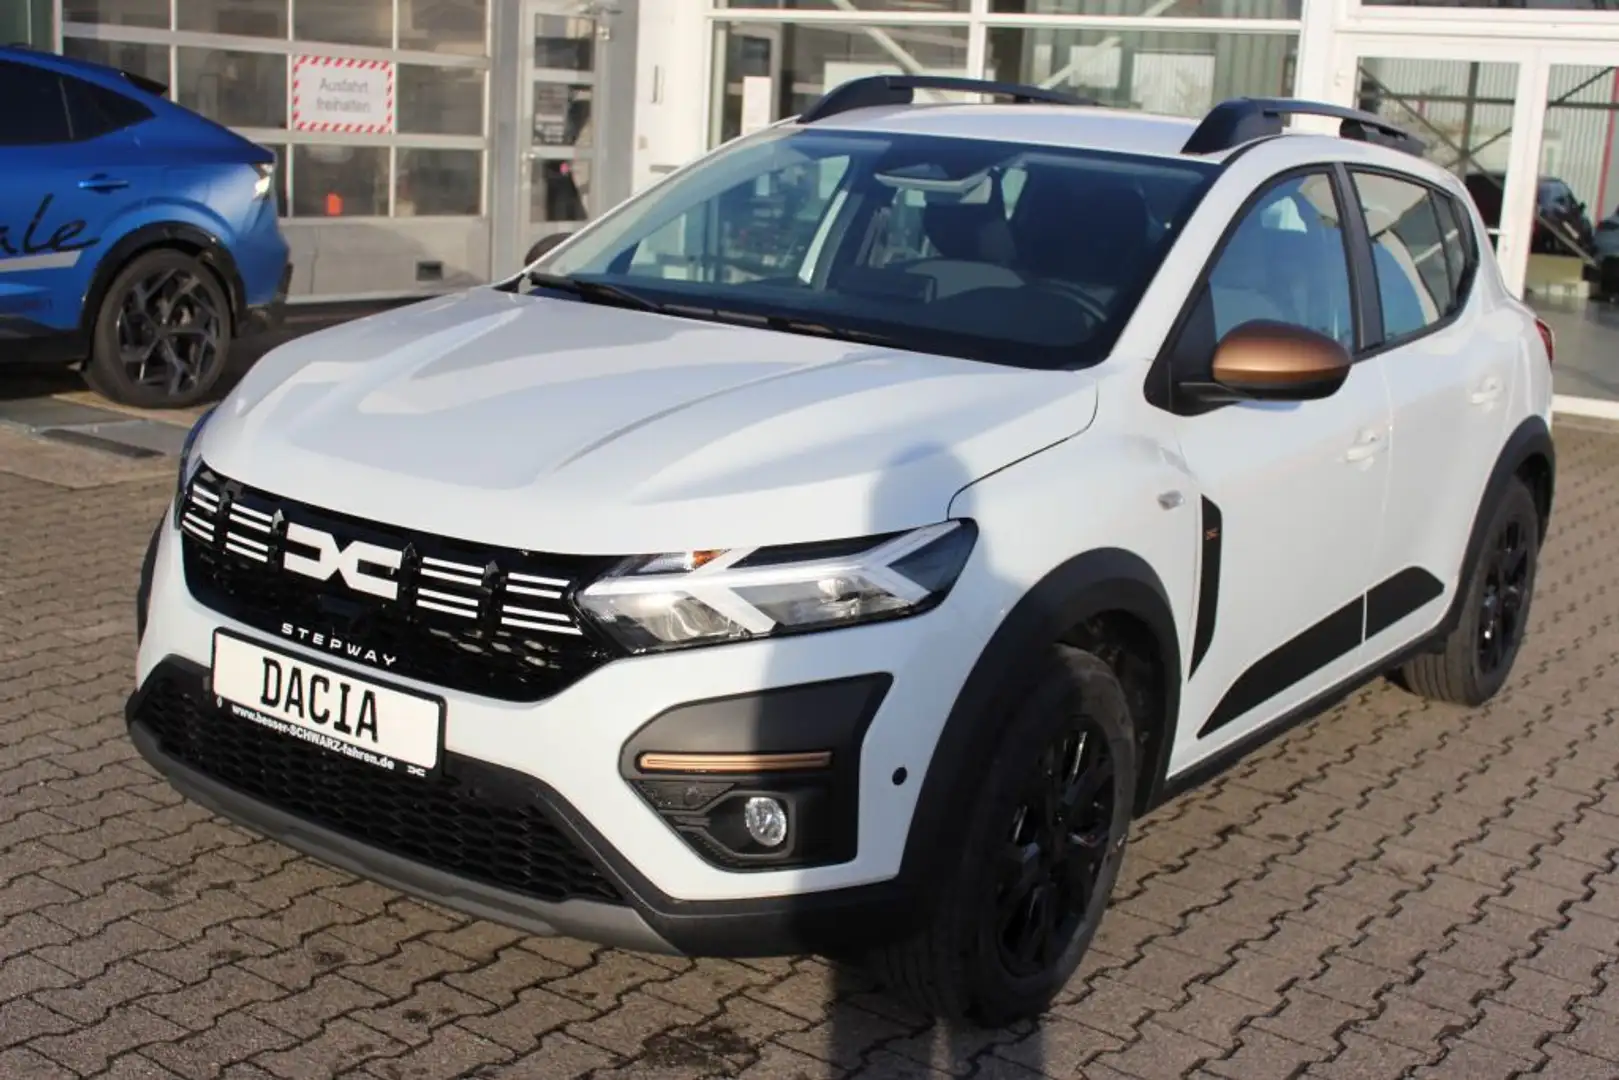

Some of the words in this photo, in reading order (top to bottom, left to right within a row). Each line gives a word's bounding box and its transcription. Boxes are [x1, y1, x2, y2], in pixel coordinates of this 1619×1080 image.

[318, 77, 369, 94] Ausfahrt
[281, 622, 397, 666] STEPWAY
[260, 656, 379, 743] DACIA
